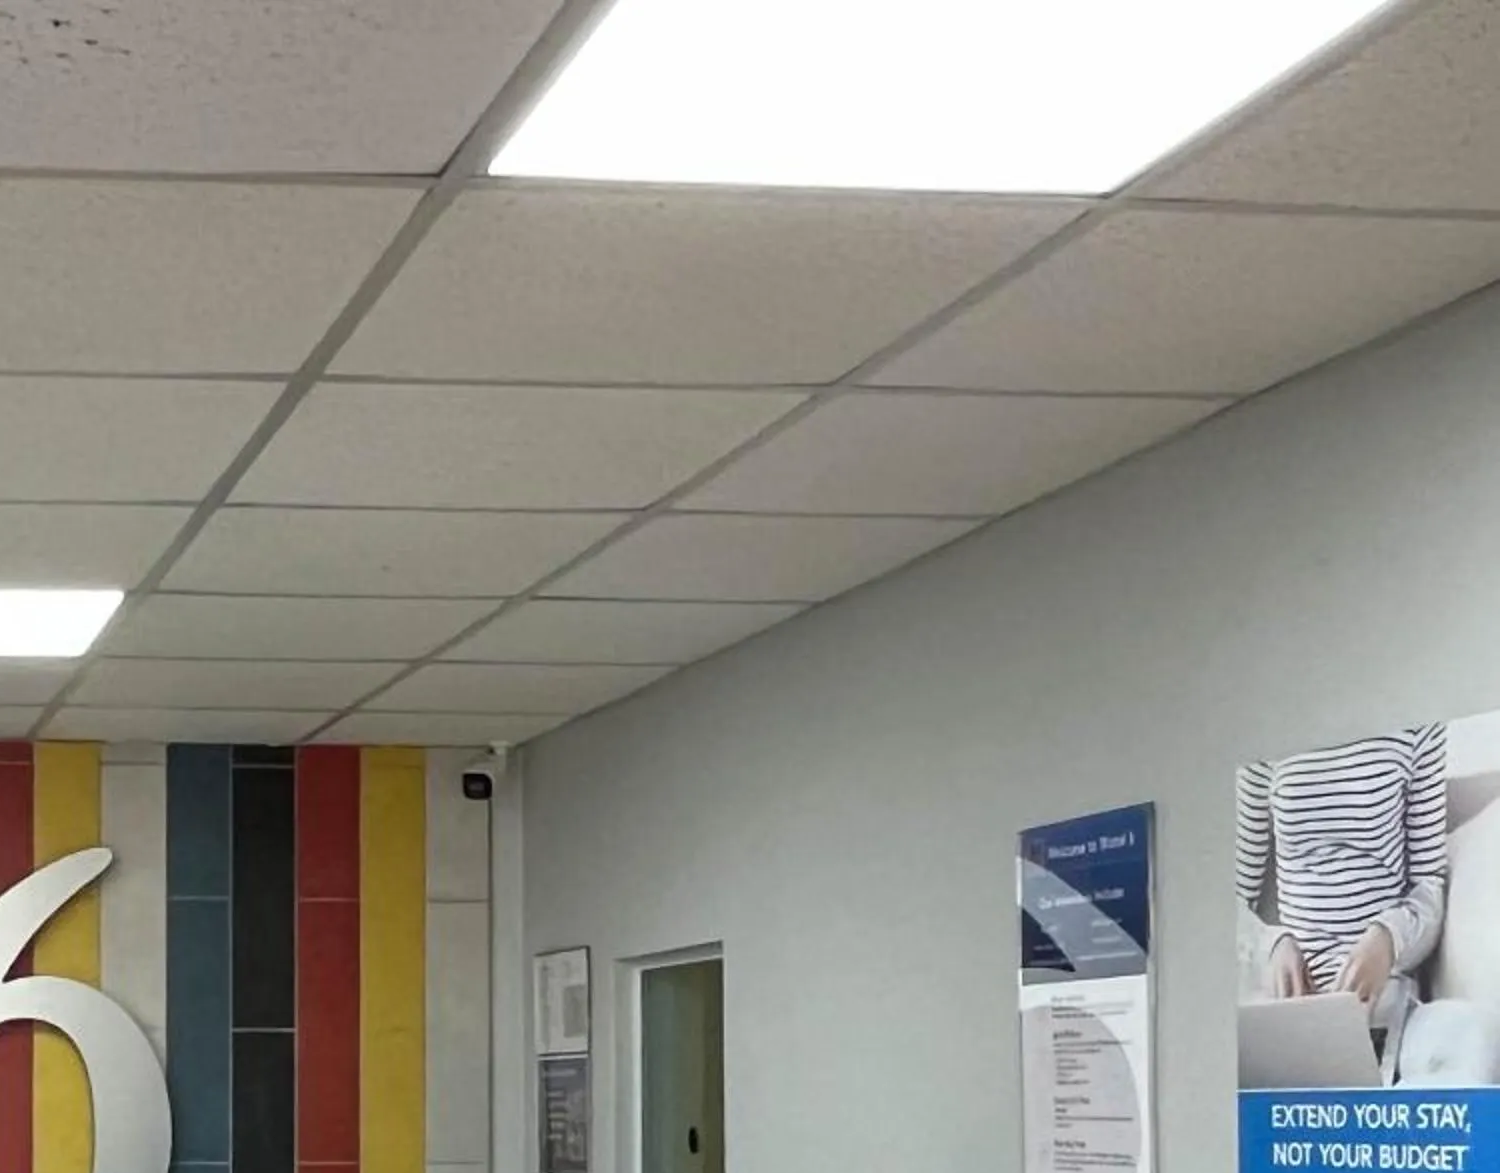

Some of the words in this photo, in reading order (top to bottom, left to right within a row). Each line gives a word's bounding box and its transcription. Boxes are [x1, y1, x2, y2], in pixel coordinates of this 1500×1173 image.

[1271, 1104, 1347, 1129] EXTEND
[1354, 1103, 1409, 1129] YOUR
[1416, 1103, 1471, 1133] STAY,
[1273, 1143, 1312, 1167] NOT
[1319, 1143, 1373, 1169] YOUR
[1379, 1145, 1470, 1171] BUDGET
